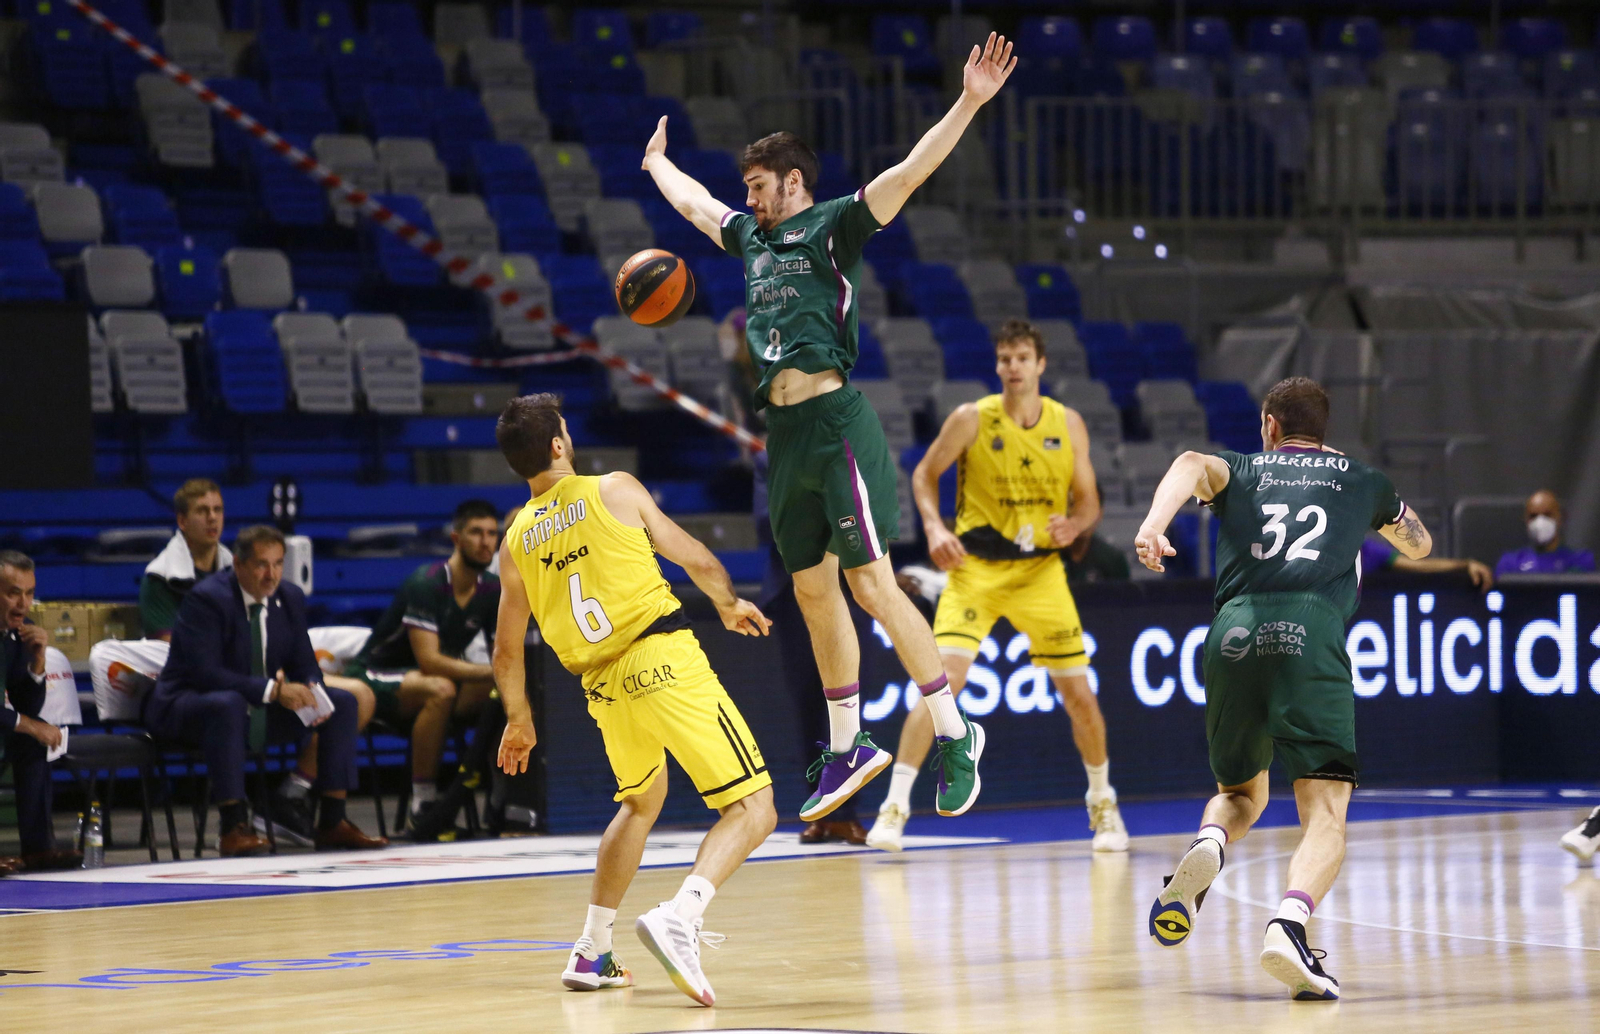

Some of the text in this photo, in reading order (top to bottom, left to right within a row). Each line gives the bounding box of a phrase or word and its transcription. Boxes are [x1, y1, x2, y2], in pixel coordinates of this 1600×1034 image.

[771, 257, 812, 275] Unicaja
[763, 327, 782, 362] 8
[1252, 454, 1350, 473] GUERRERO
[522, 498, 587, 556] FITIPALDO
[1250, 503, 1328, 561] 32
[568, 572, 614, 644] 6
[1256, 633, 1305, 647] DEL SOL
[1258, 621, 1307, 637] COSTA
[1345, 591, 1600, 698] elicid
[622, 665, 676, 694] CICAR
